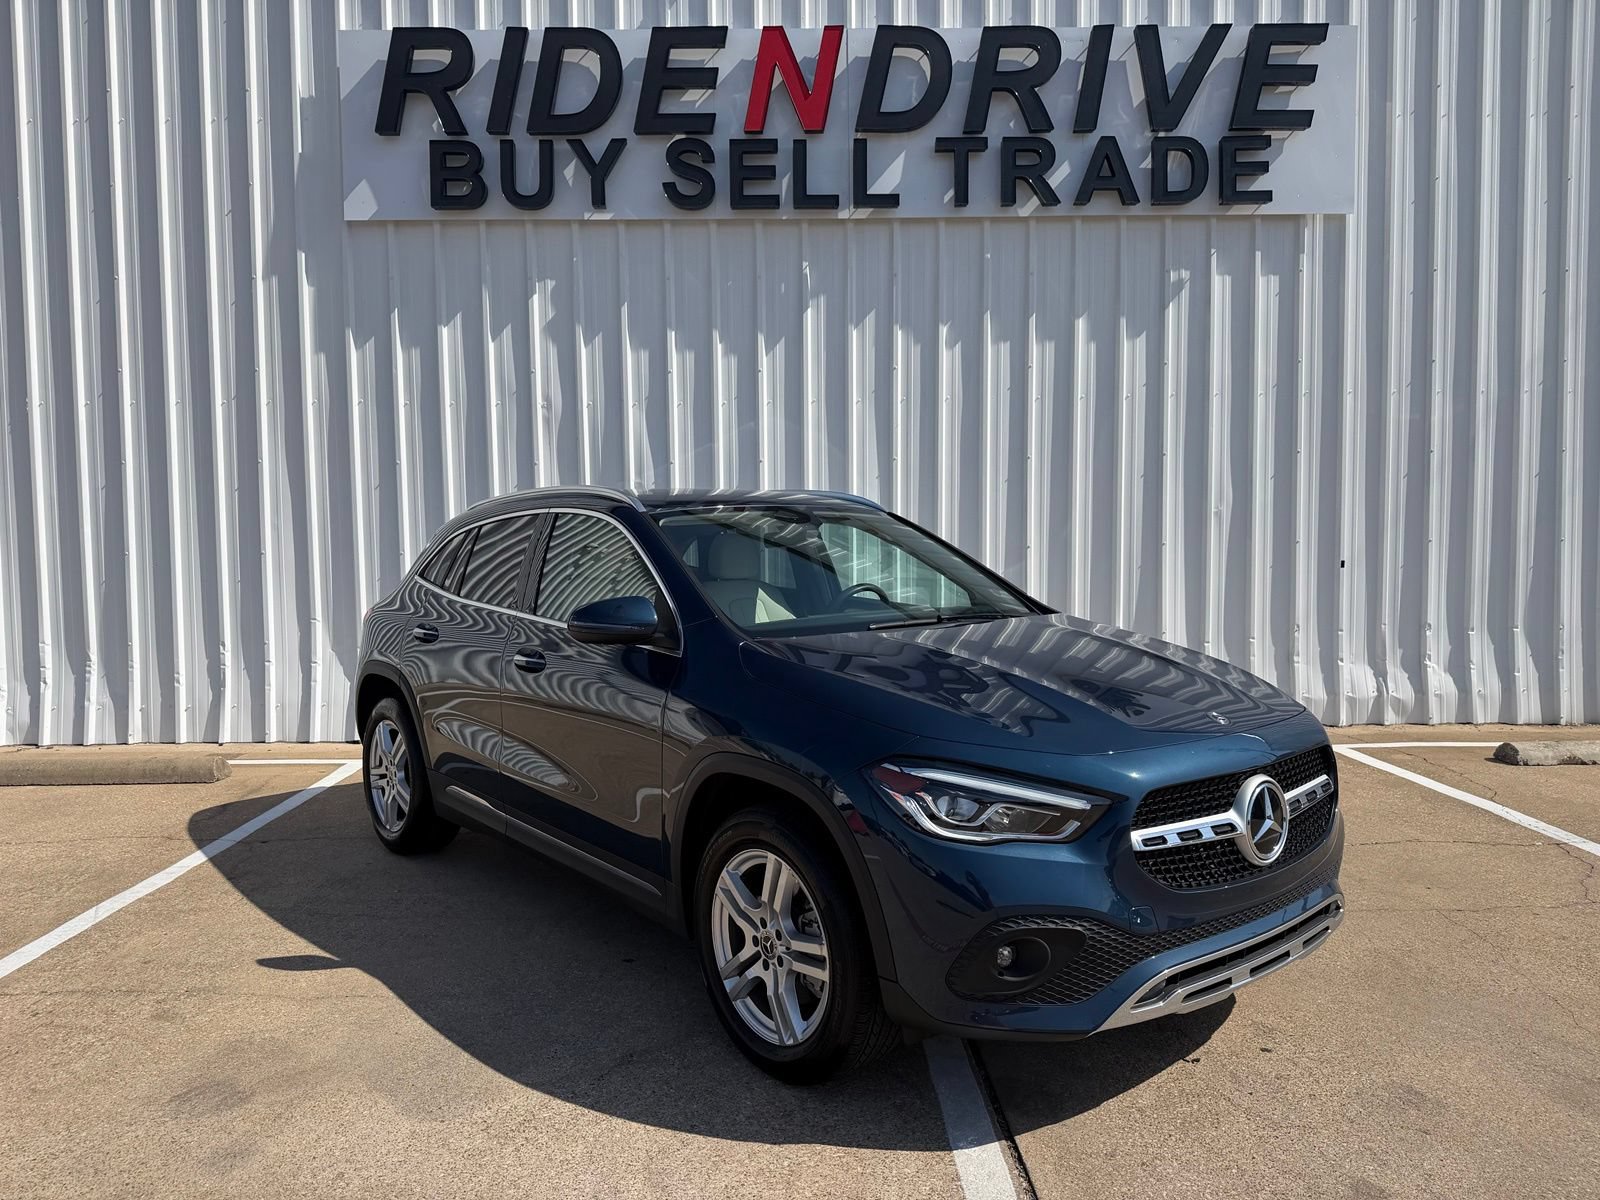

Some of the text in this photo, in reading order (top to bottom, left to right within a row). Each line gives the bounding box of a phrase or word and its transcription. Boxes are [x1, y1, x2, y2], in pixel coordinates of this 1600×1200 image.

[429, 135, 1273, 210] BUY SELL TRADE
